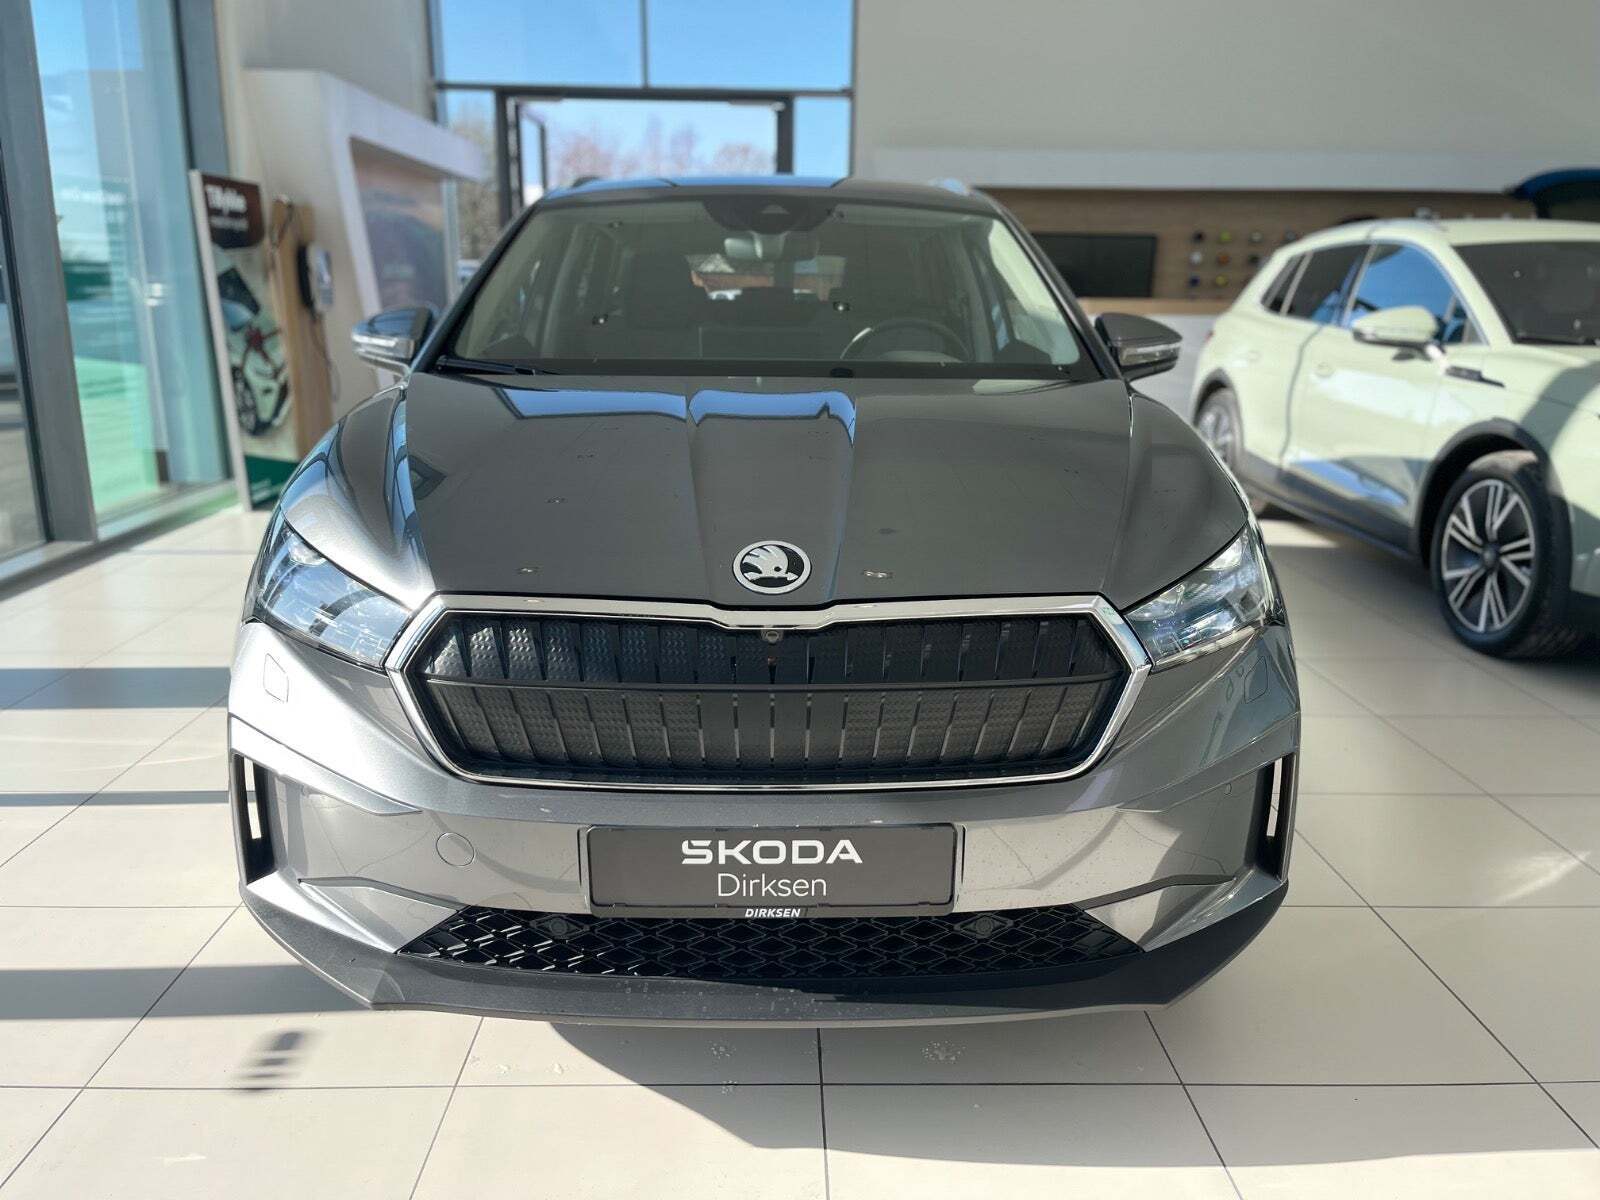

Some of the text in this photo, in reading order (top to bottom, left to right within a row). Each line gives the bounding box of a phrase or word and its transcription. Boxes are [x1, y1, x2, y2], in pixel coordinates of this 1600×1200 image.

[681, 839, 863, 865] SKODA
[717, 872, 827, 897] Dirksen
[744, 907, 801, 918] DIRKSEN
